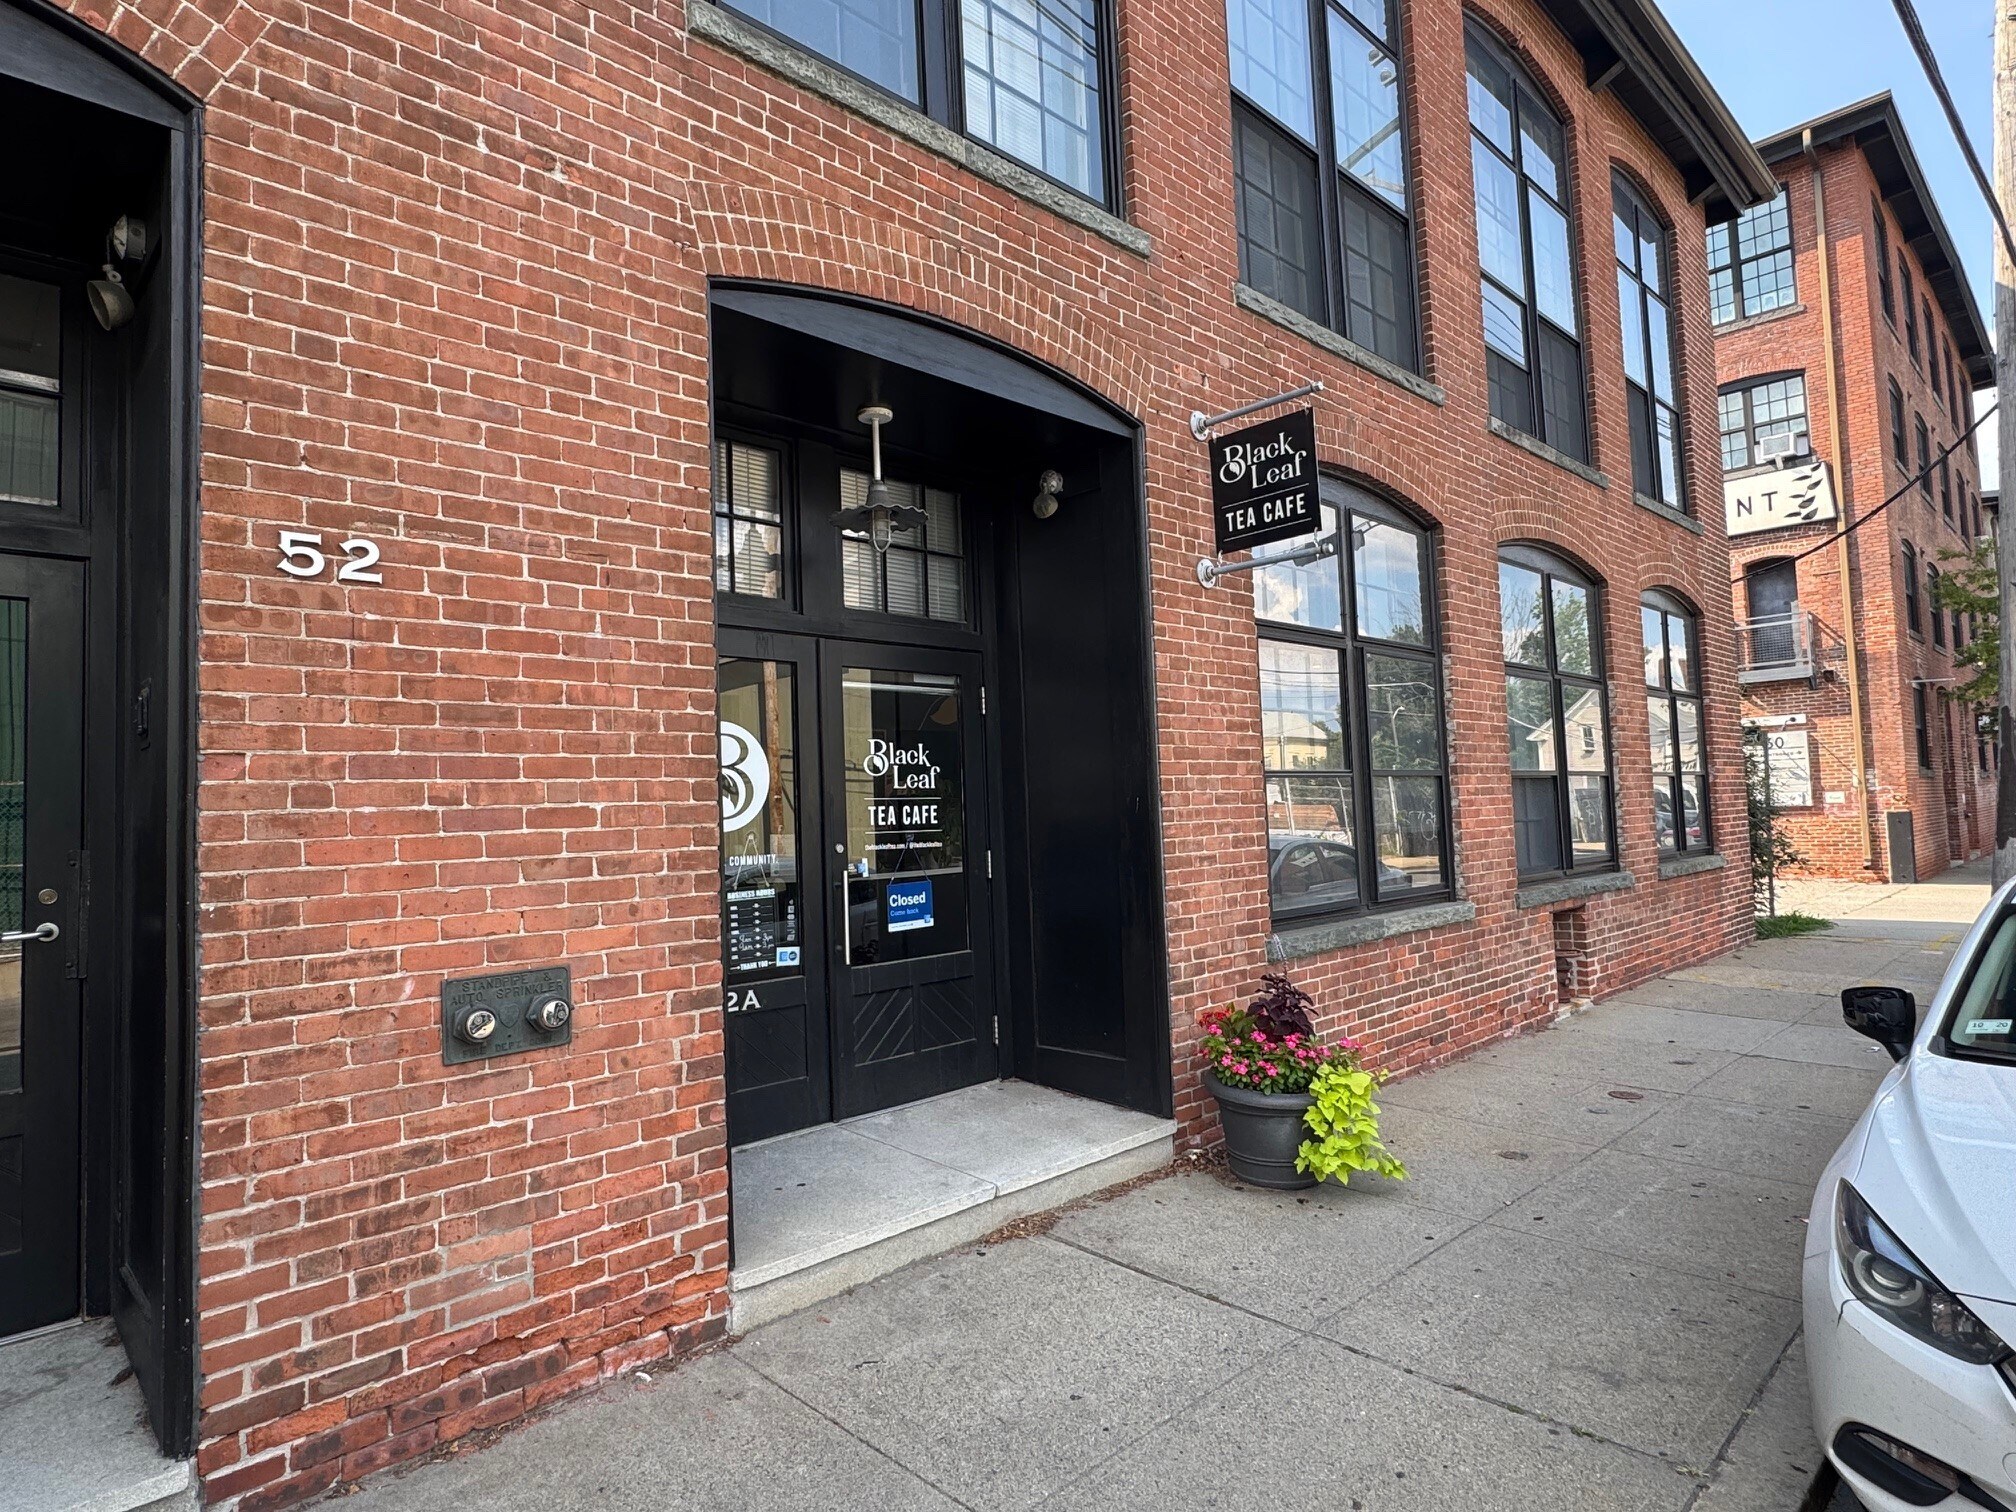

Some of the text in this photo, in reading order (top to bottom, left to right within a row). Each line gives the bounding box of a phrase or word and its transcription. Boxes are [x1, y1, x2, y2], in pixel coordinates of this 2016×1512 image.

[1220, 432, 1295, 483] Black
[1251, 450, 1307, 489] Leaf
[1225, 493, 1306, 532] TEA CAFE
[277, 530, 383, 584] 52
[863, 739, 931, 776] Black
[893, 765, 940, 789] Leaf
[868, 805, 938, 826] TEA CAFE
[889, 891, 926, 907] Closed
[890, 907, 919, 917] Come back
[462, 973, 529, 992] STANDPIPE
[496, 979, 564, 999] SPRINKLER
